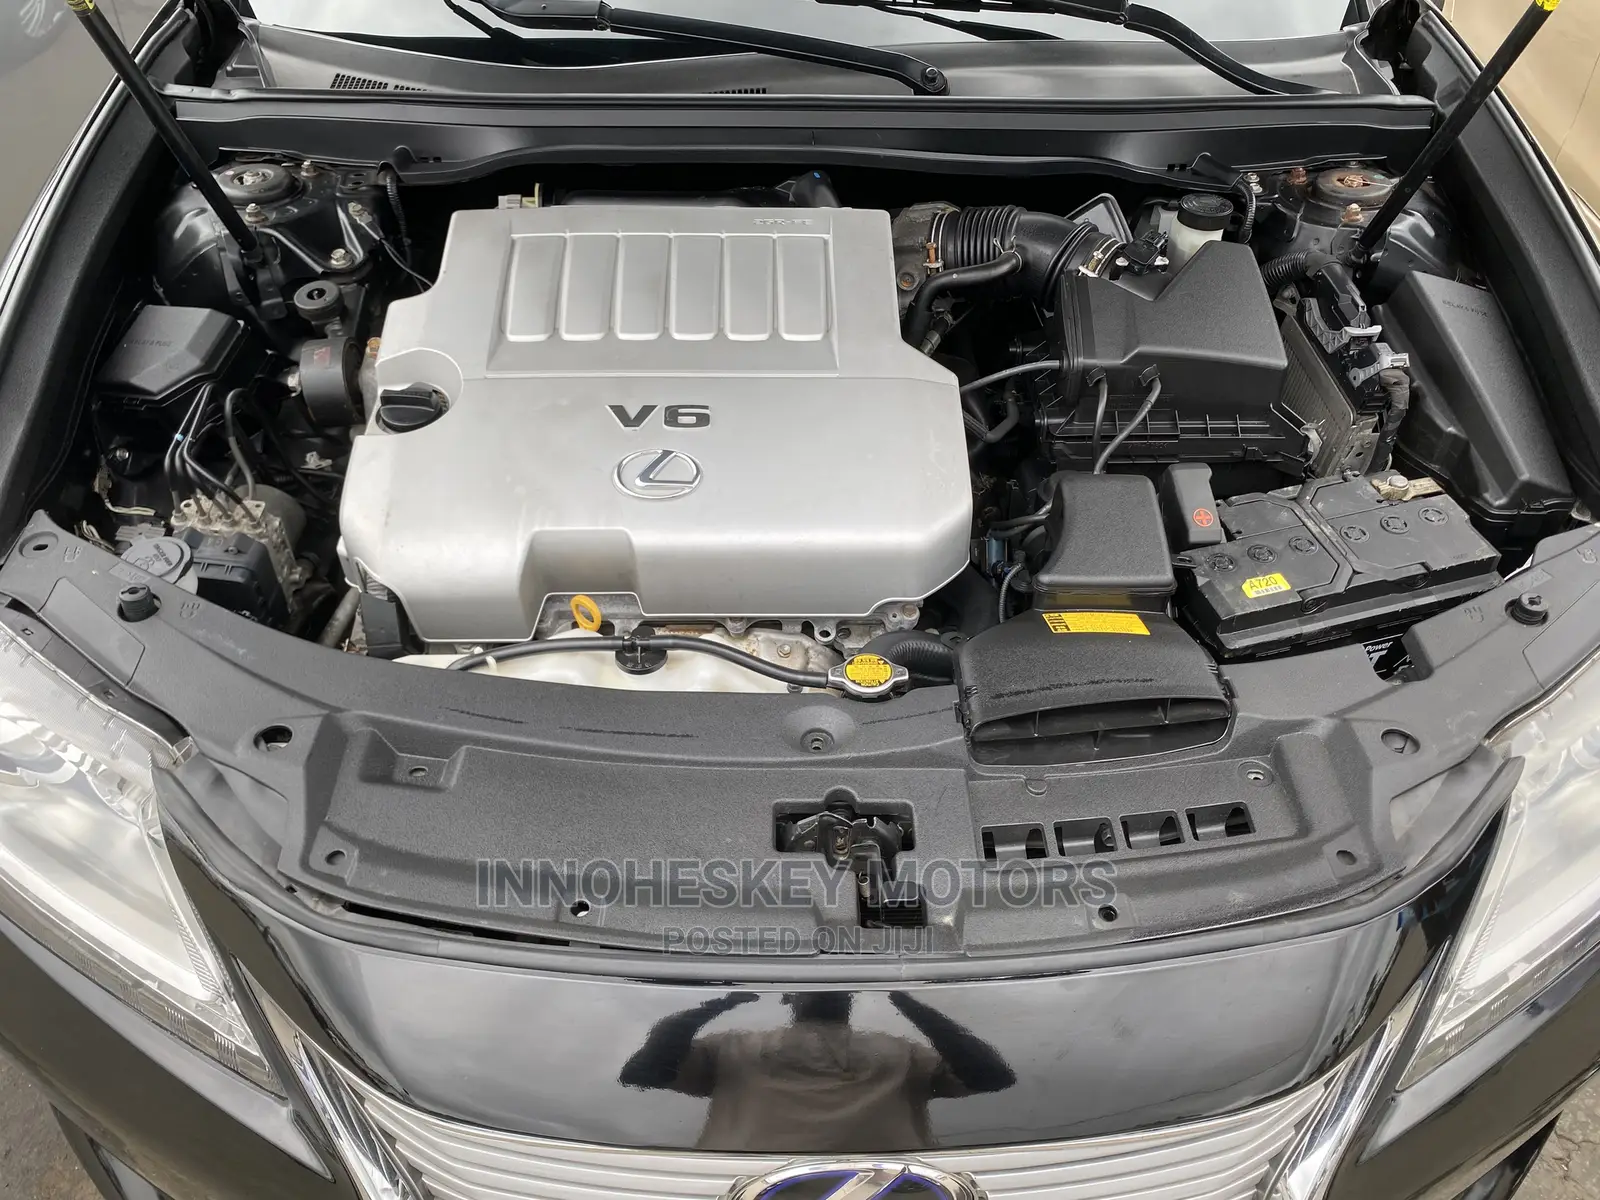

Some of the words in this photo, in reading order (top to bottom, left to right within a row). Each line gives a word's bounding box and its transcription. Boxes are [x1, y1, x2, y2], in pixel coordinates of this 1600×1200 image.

[604, 404, 711, 429] V6
[1249, 576, 1278, 590] A720
[1365, 641, 1394, 652] Power
